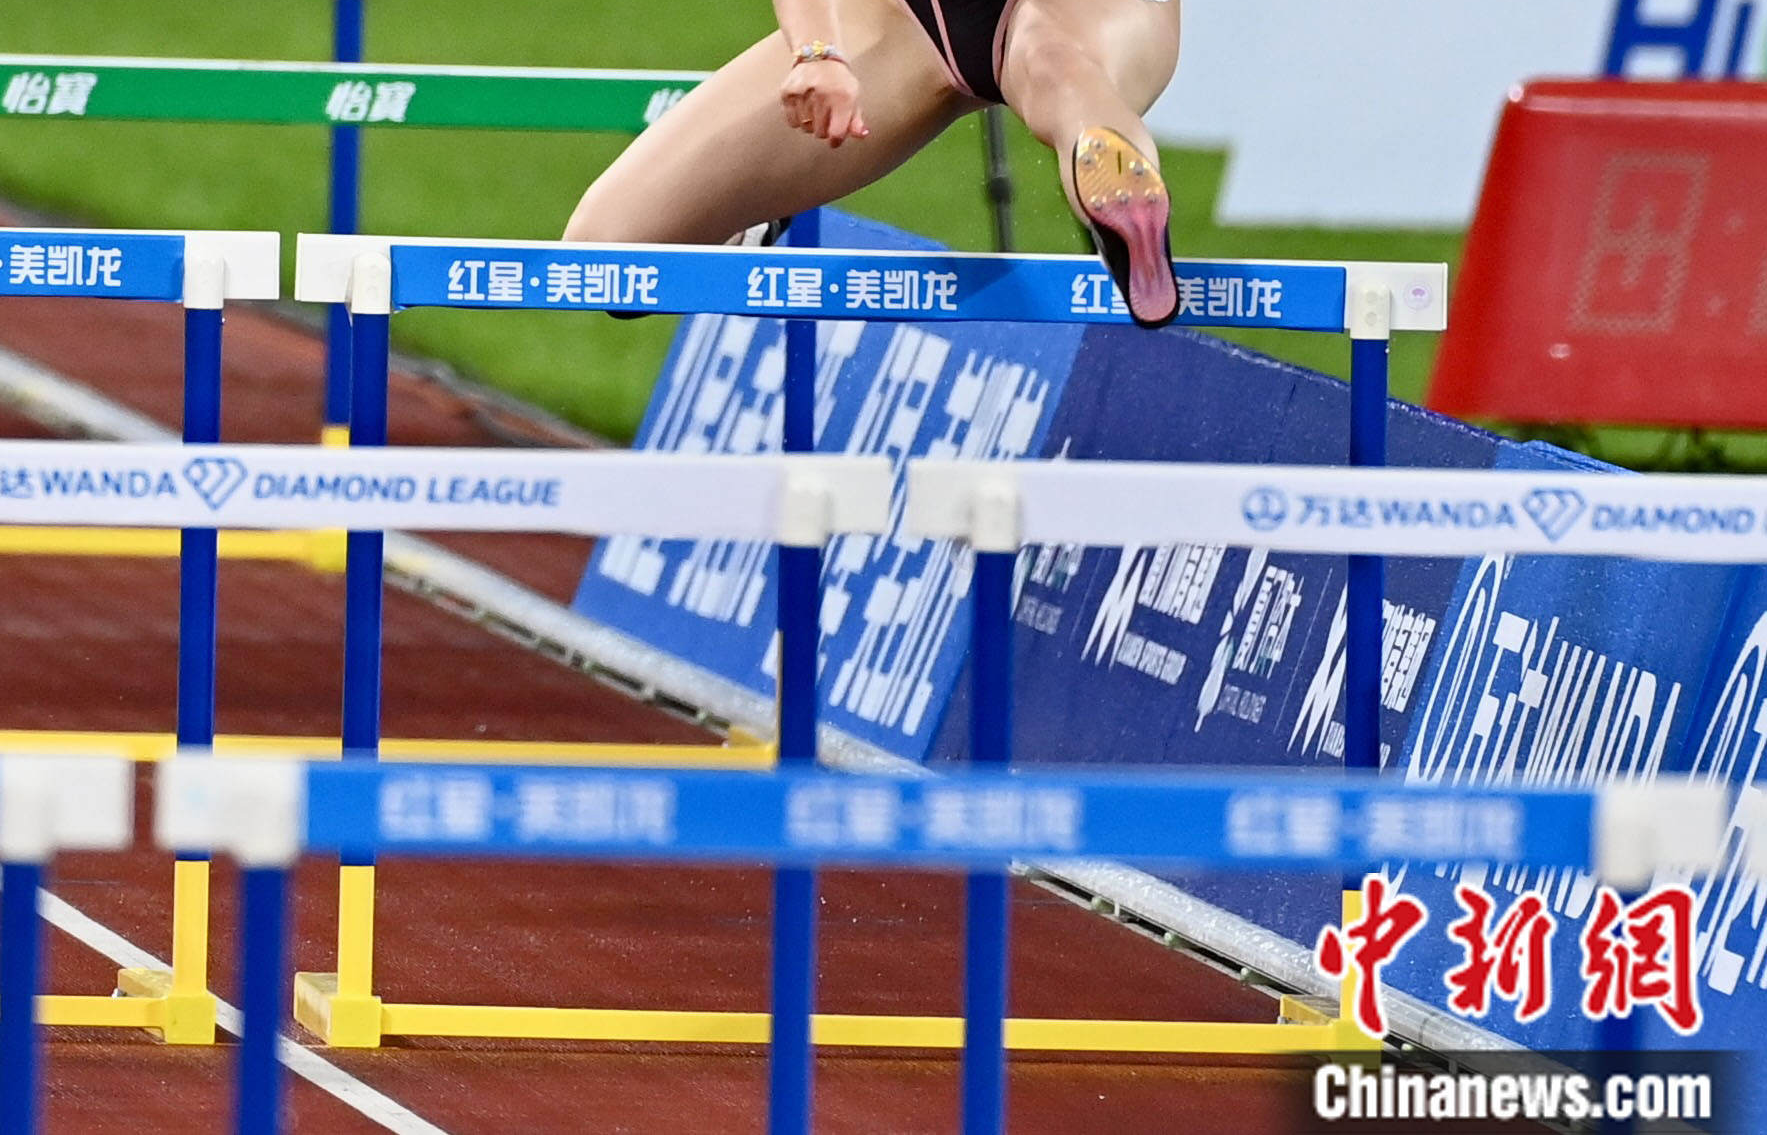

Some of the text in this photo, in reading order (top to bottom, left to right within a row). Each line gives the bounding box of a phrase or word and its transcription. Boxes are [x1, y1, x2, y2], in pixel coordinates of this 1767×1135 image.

[447, 260, 659, 305] 红星·美凯龙
[746, 266, 958, 311] 红星·美凯龙
[252, 473, 418, 504] DIAMOND
[426, 476, 563, 507] LEAGUE
[1591, 504, 1757, 535] DIAMOND
